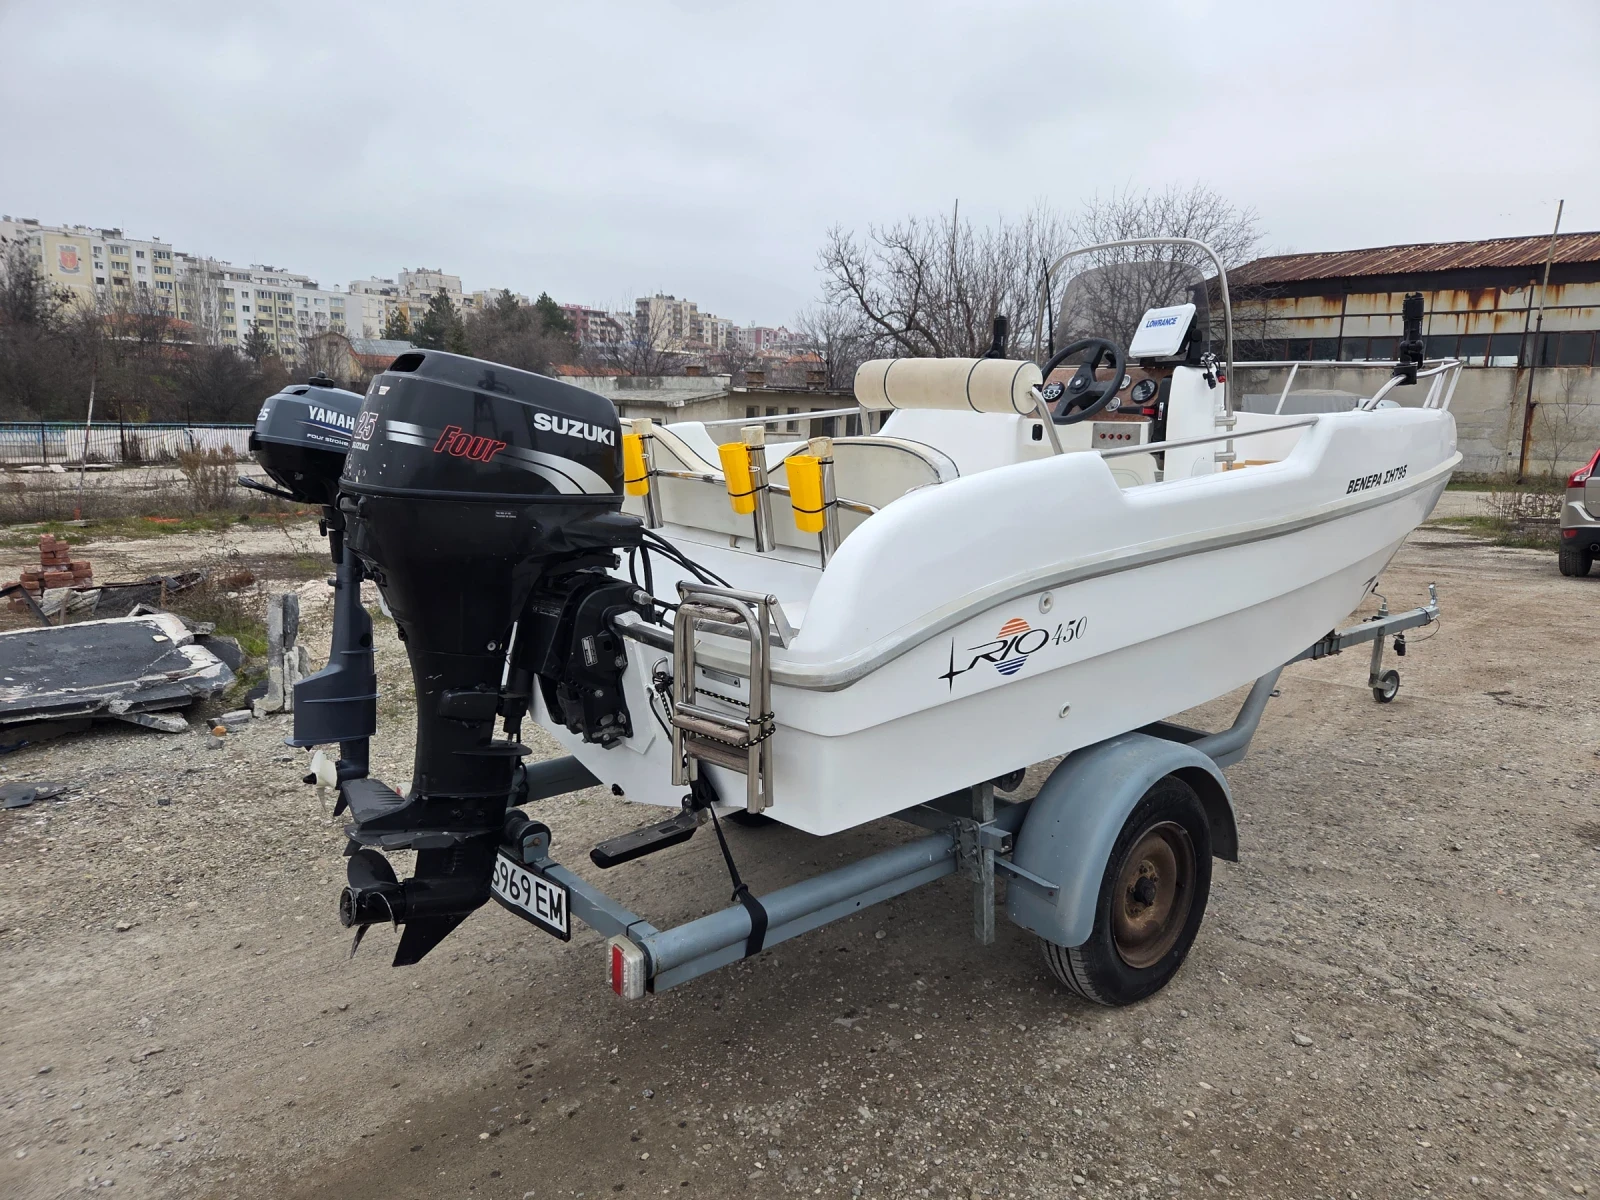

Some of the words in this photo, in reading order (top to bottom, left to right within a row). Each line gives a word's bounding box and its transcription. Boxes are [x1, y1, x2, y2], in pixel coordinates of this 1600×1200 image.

[1146, 317, 1177, 328] LOWRANCE
[308, 405, 355, 430] YAMAH
[354, 411, 379, 440] 25
[533, 412, 615, 447] SUZUKI
[433, 424, 507, 463] Four
[960, 628, 1050, 672] RIO
[1051, 616, 1088, 646] 450
[535, 881, 563, 926] EM
